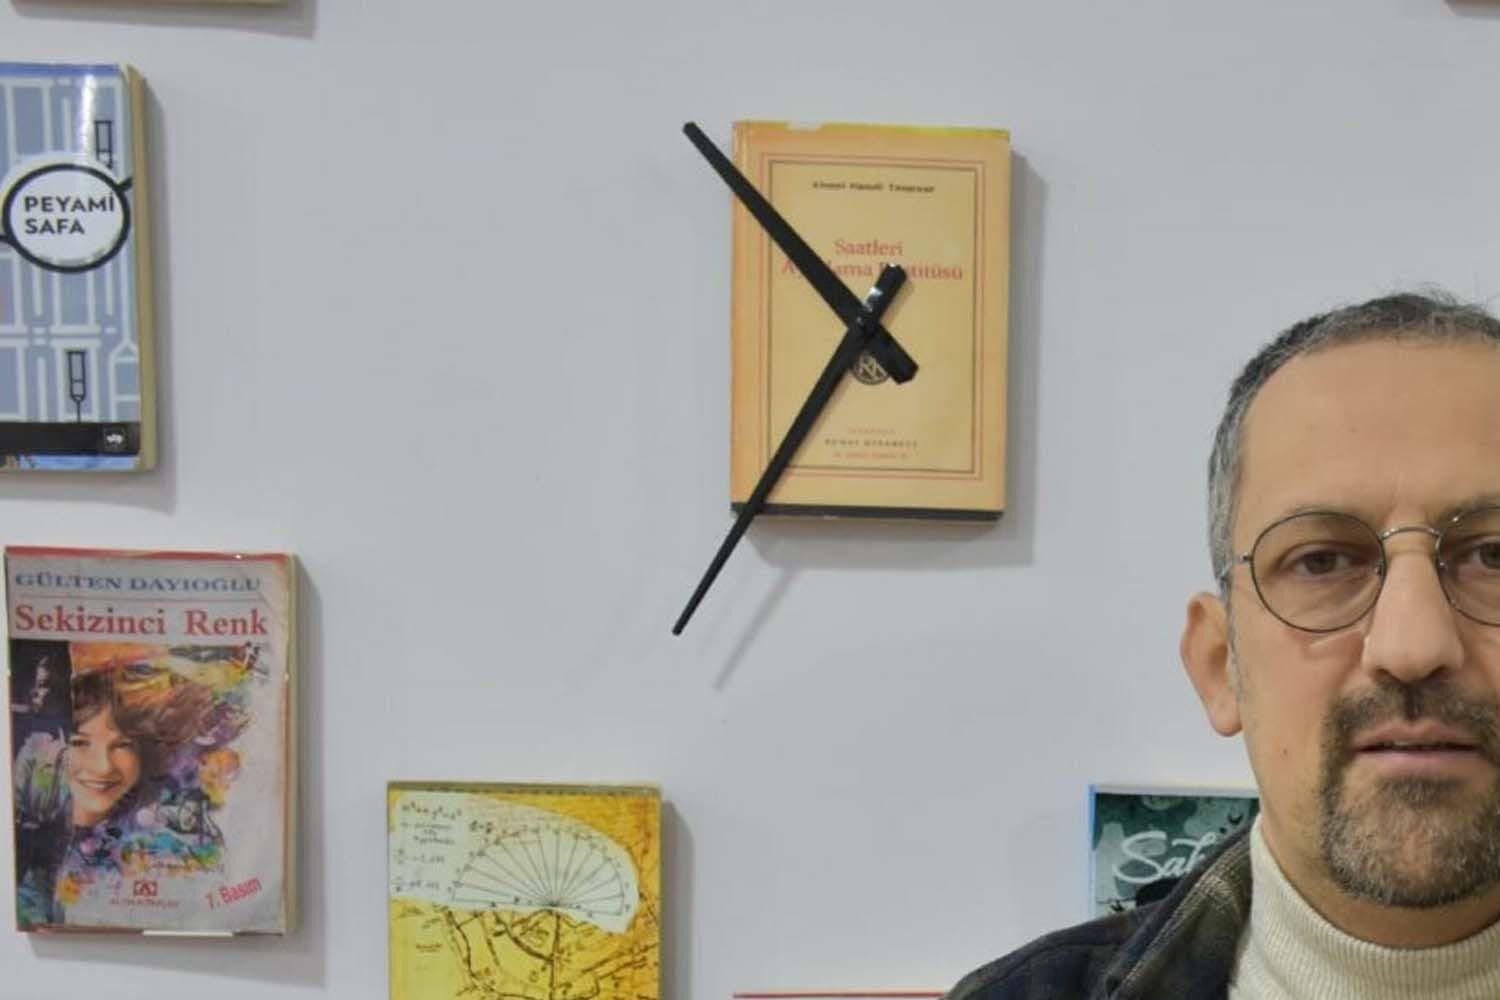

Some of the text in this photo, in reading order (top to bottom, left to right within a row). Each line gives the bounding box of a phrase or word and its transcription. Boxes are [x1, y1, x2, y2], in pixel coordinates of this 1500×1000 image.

[24, 192, 115, 213] PEYAMİ
[25, 219, 85, 235] SAFA
[834, 238, 904, 257] Saatleri
[15, 572, 122, 591] GÜLTEN
[15, 604, 268, 636] Sekizinci Renk
